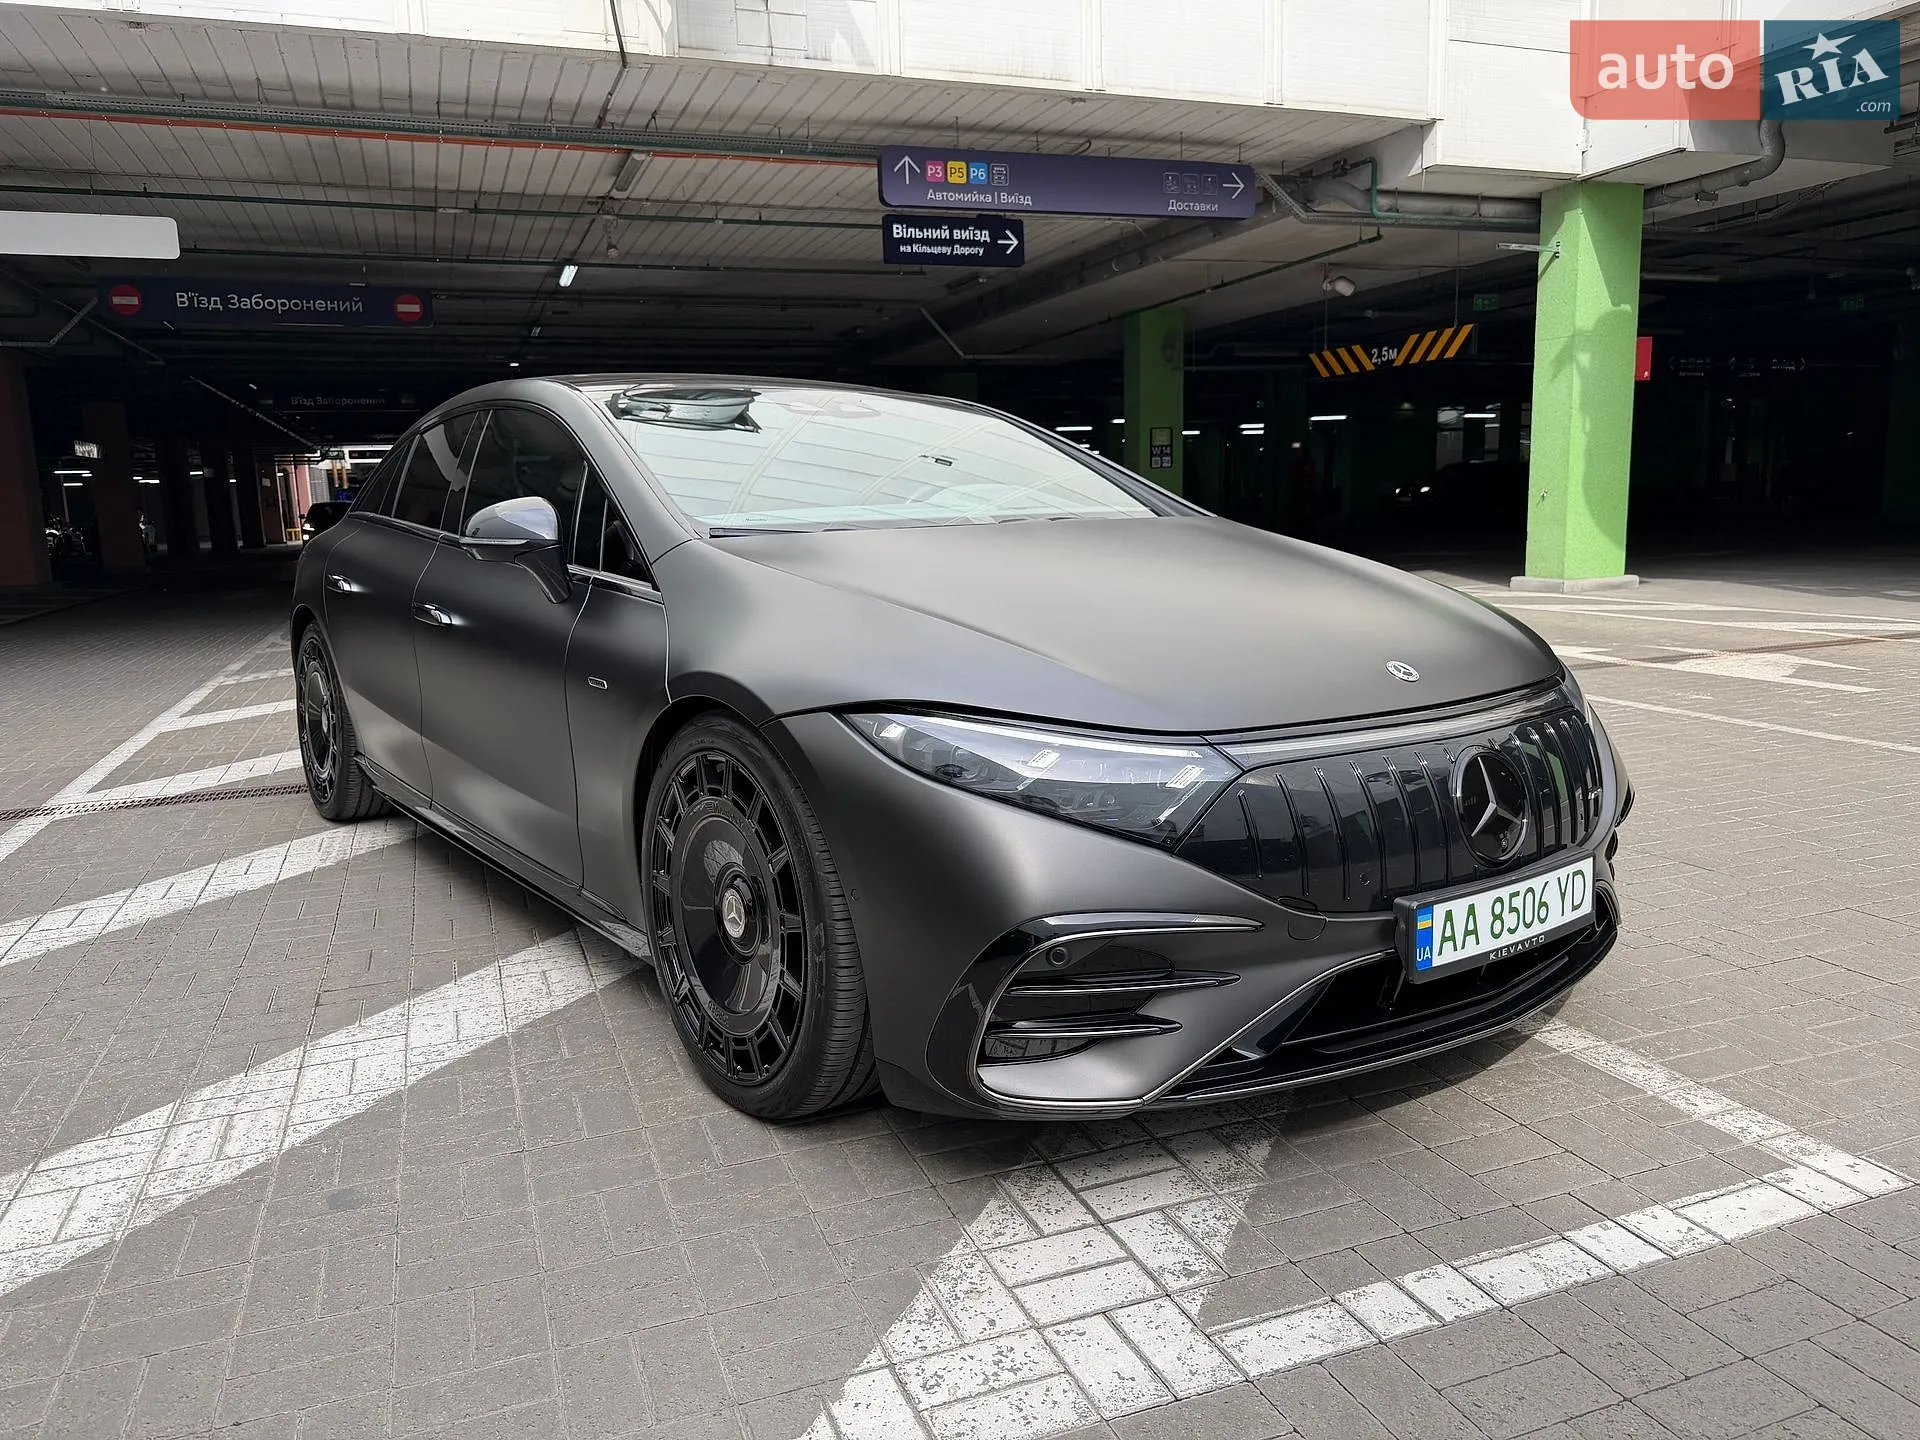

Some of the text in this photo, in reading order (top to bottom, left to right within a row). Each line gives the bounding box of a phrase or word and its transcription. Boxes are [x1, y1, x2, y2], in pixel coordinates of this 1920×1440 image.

[927, 164, 986, 180] P3 P5 P6
[926, 188, 1033, 206] Автомийка Виїзд
[1167, 199, 1219, 212] Доставки
[892, 223, 991, 243] Вільний виїзд
[899, 243, 985, 257] на Кільцеву Дорогу
[175, 292, 363, 313] В'їзд Заборонений
[1437, 868, 1587, 957] AA 8506 YD
[1416, 946, 1432, 961] UA
[1489, 935, 1545, 960] KIEVAVTO
